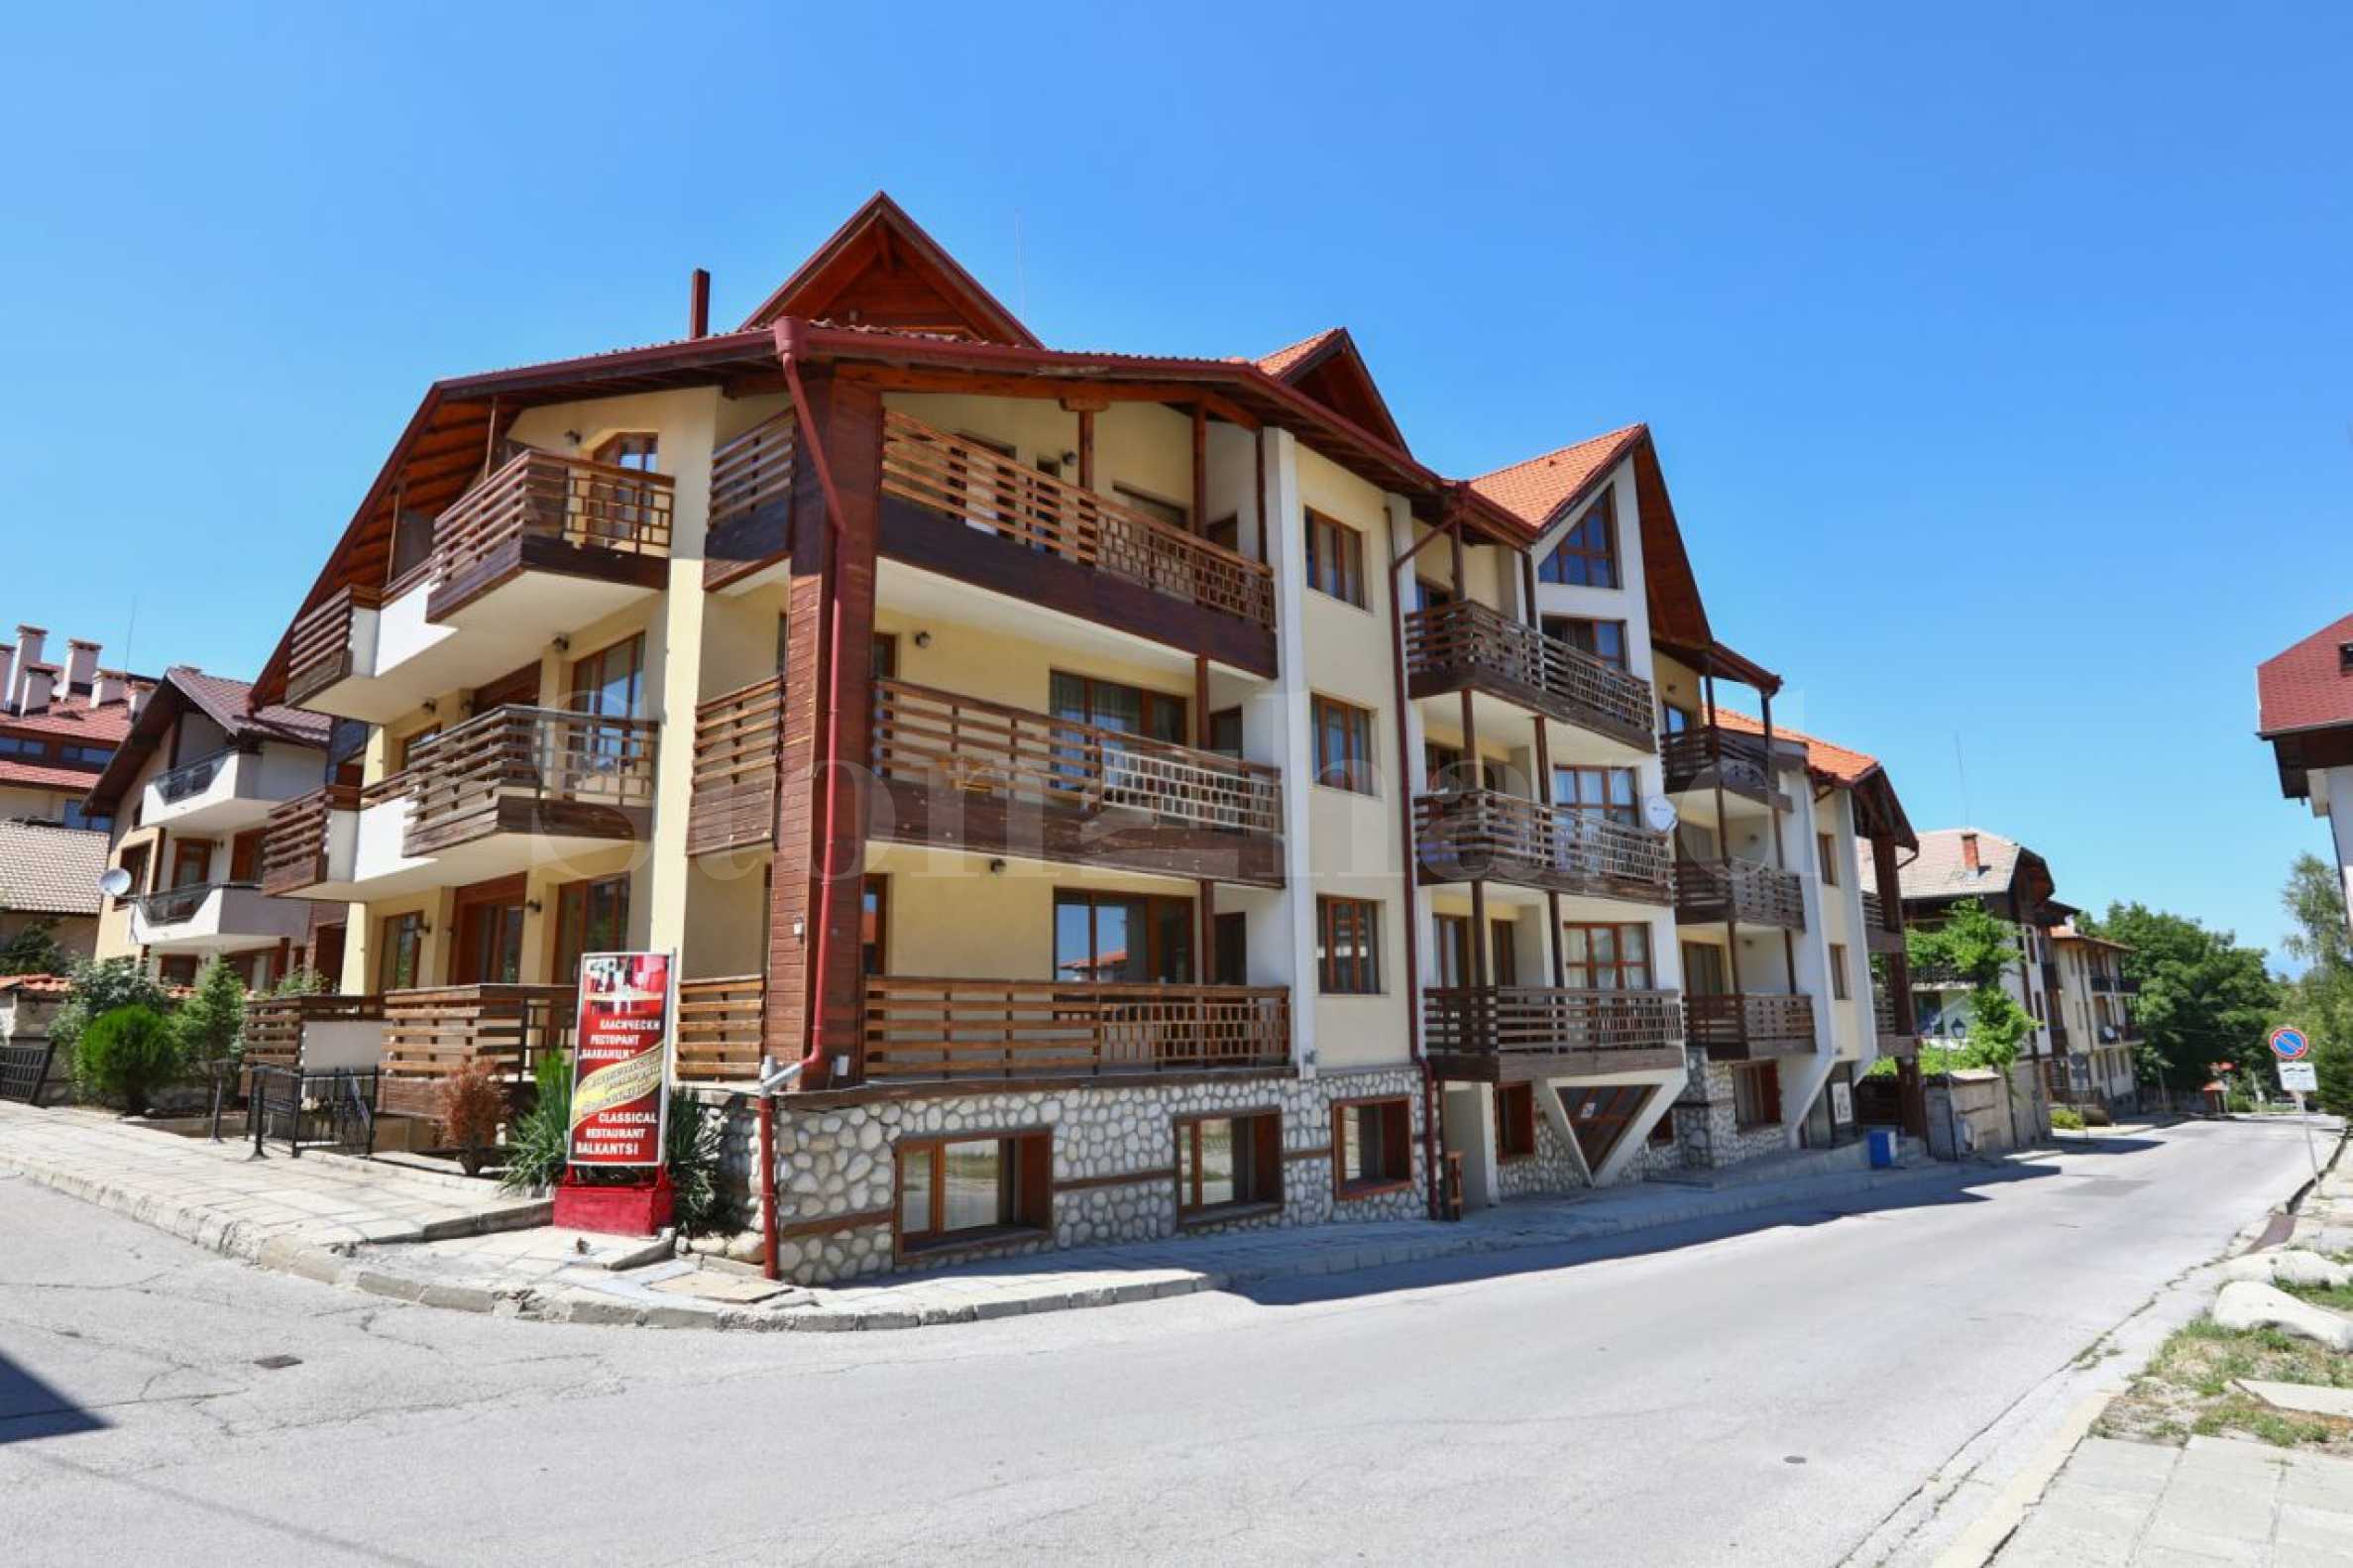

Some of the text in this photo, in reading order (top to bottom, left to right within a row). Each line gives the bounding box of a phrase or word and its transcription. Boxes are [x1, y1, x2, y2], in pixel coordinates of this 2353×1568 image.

[590, 1034, 640, 1046] РЕСТОРАНТ
[599, 1111, 657, 1124] CLASSICAL
[586, 1128, 646, 1139] RESTAURANT
[576, 1142, 638, 1155] BALKANTSI
